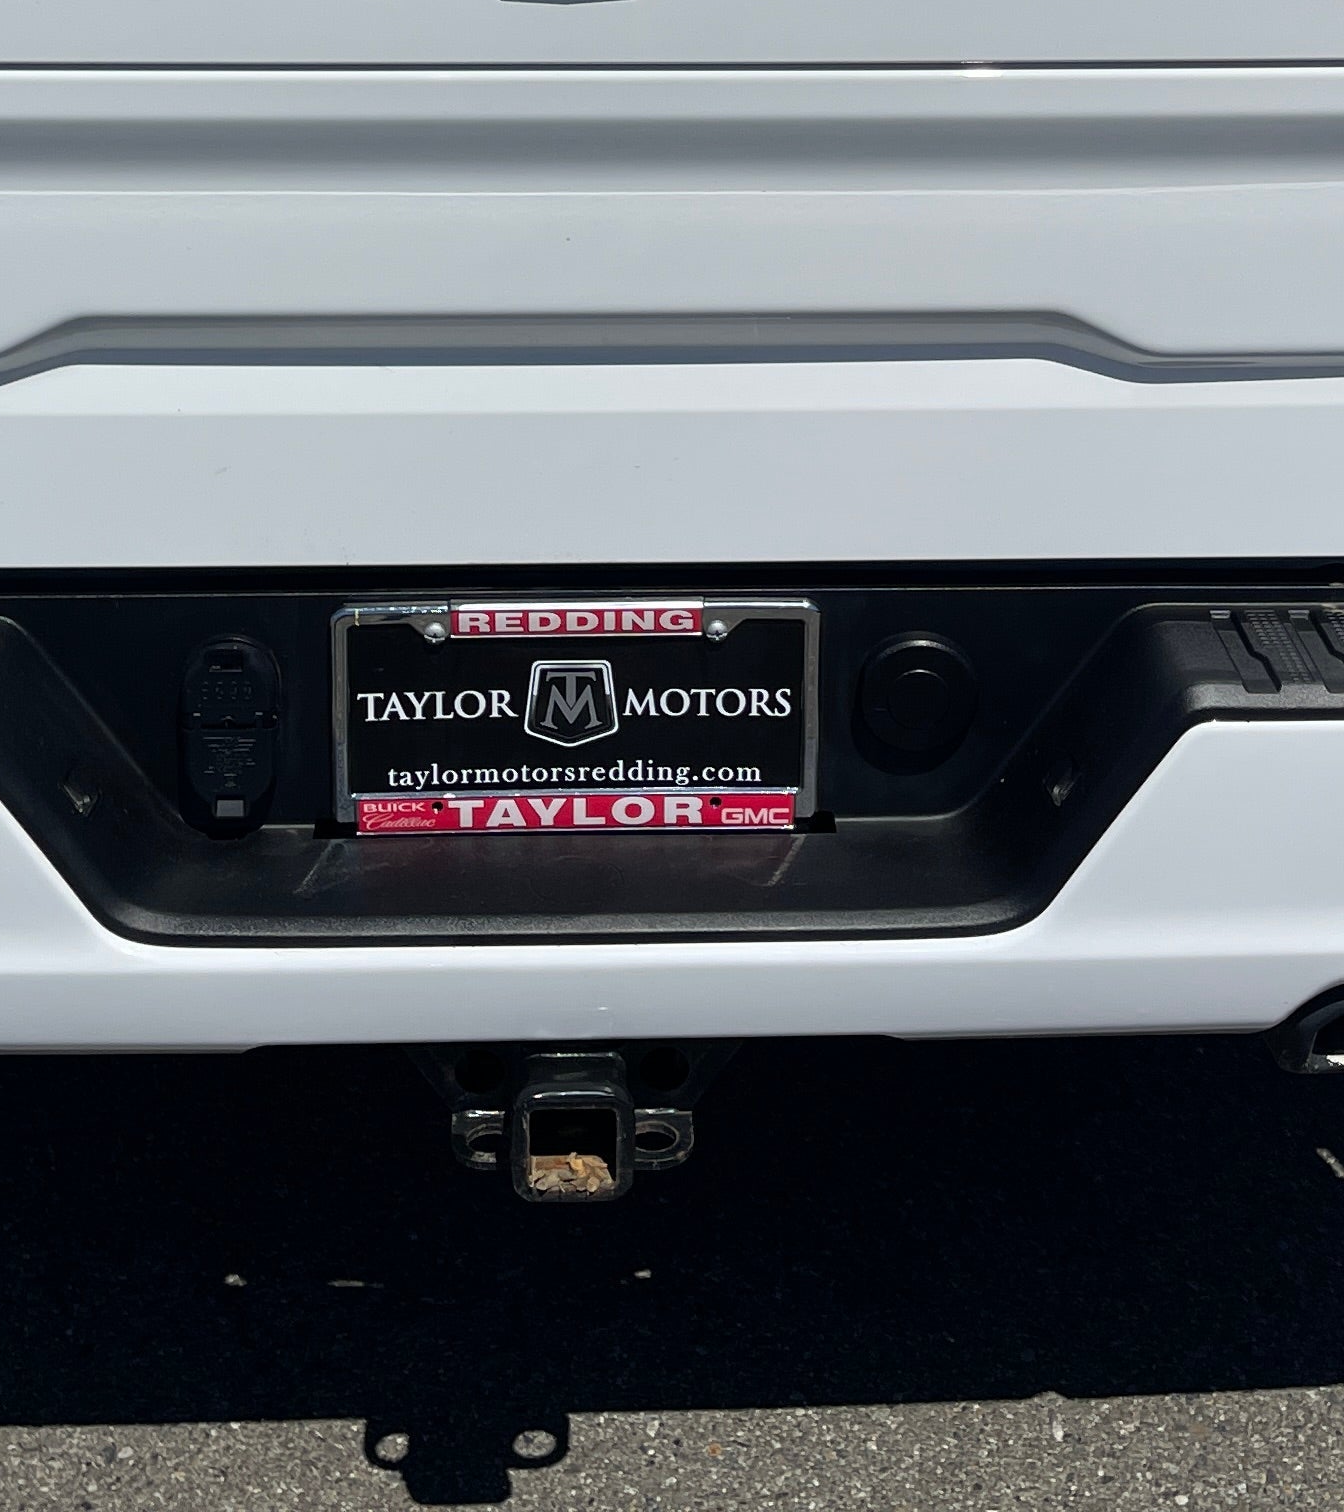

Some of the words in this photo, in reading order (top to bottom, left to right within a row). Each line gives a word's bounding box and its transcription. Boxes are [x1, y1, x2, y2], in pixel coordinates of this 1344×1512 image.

[458, 609, 695, 633] REDDING
[357, 689, 518, 722] TAYLOR
[623, 687, 792, 718] MOTORS
[387, 760, 761, 790] taylormotorsredding.com
[362, 813, 436, 831] Cadillac
[363, 802, 426, 813] BUICK
[448, 797, 704, 829] TAYLOR
[721, 807, 790, 825] GMC
